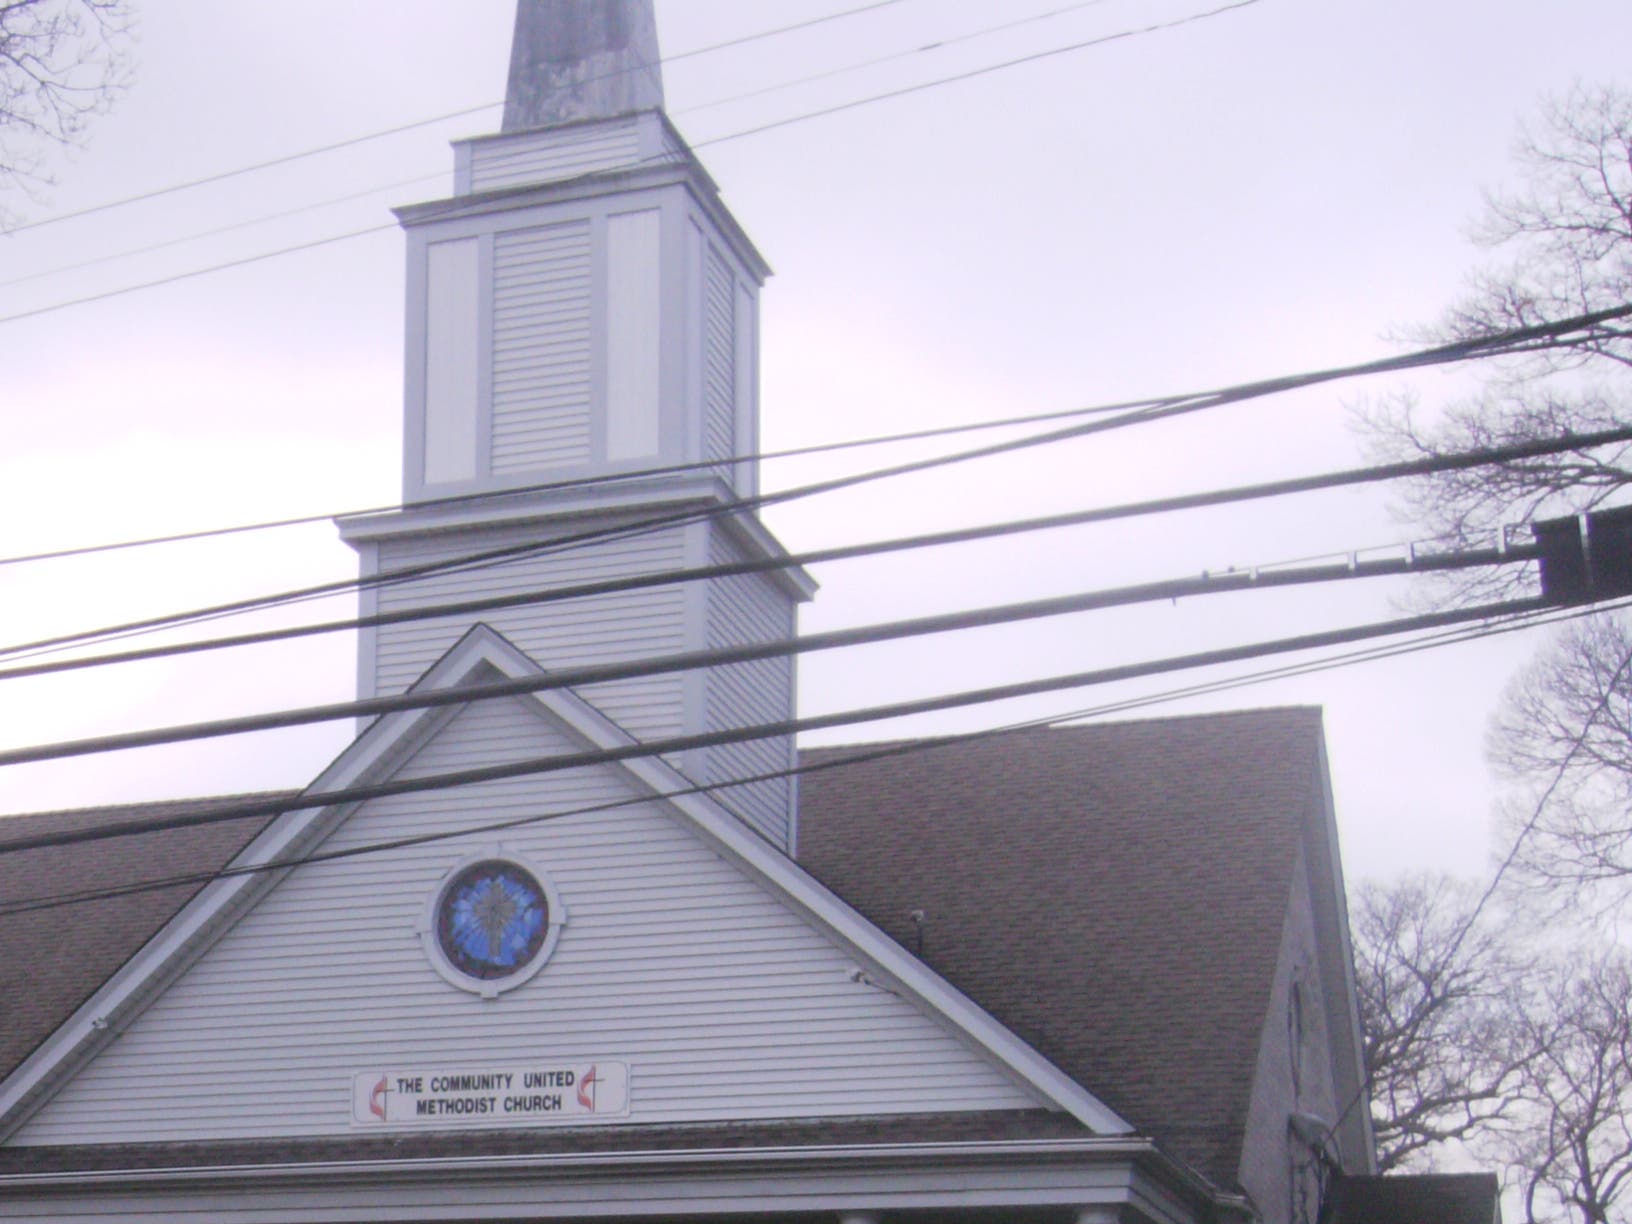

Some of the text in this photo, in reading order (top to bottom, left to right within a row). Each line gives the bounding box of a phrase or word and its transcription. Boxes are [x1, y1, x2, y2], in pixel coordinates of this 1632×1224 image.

[397, 1071, 575, 1094] THE COMMUNITY UNITED
[416, 1094, 562, 1115] METHODIST CHURCH
